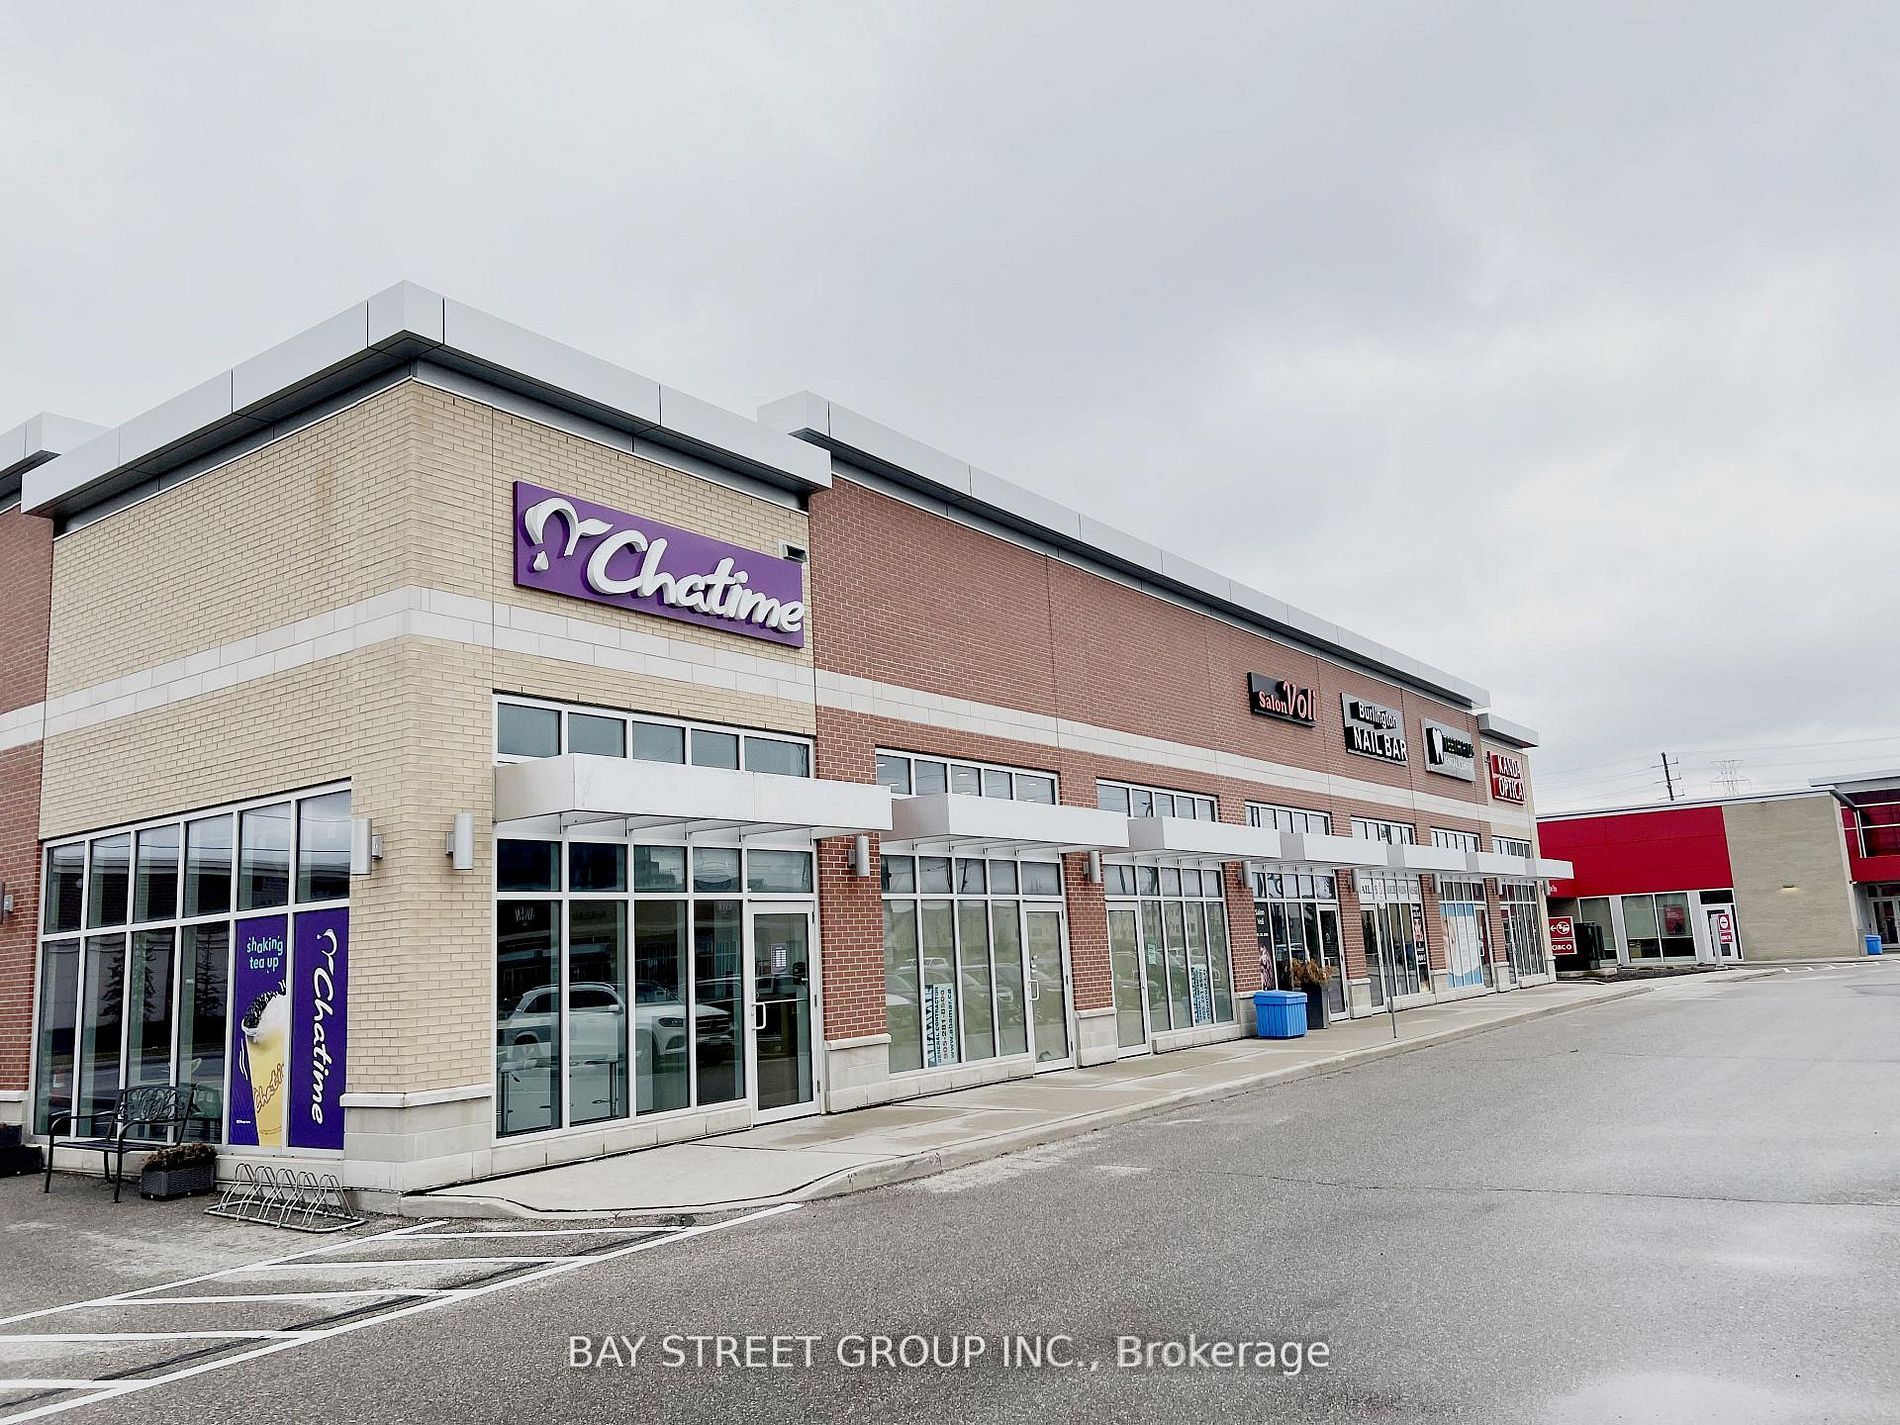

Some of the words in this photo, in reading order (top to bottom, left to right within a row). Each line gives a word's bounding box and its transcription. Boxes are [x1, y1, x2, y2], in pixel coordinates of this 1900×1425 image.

[587, 530, 804, 632] Chatime
[1259, 690, 1287, 714] Salon
[1283, 680, 1317, 720] Voli
[1358, 701, 1397, 728] Burlington
[1353, 726, 1383, 754] NAIL
[1384, 734, 1408, 761] BAR
[246, 935, 284, 956] shaking
[250, 956, 265, 970] tea
[266, 956, 279, 972] up
[311, 968, 334, 1125] Chatime
